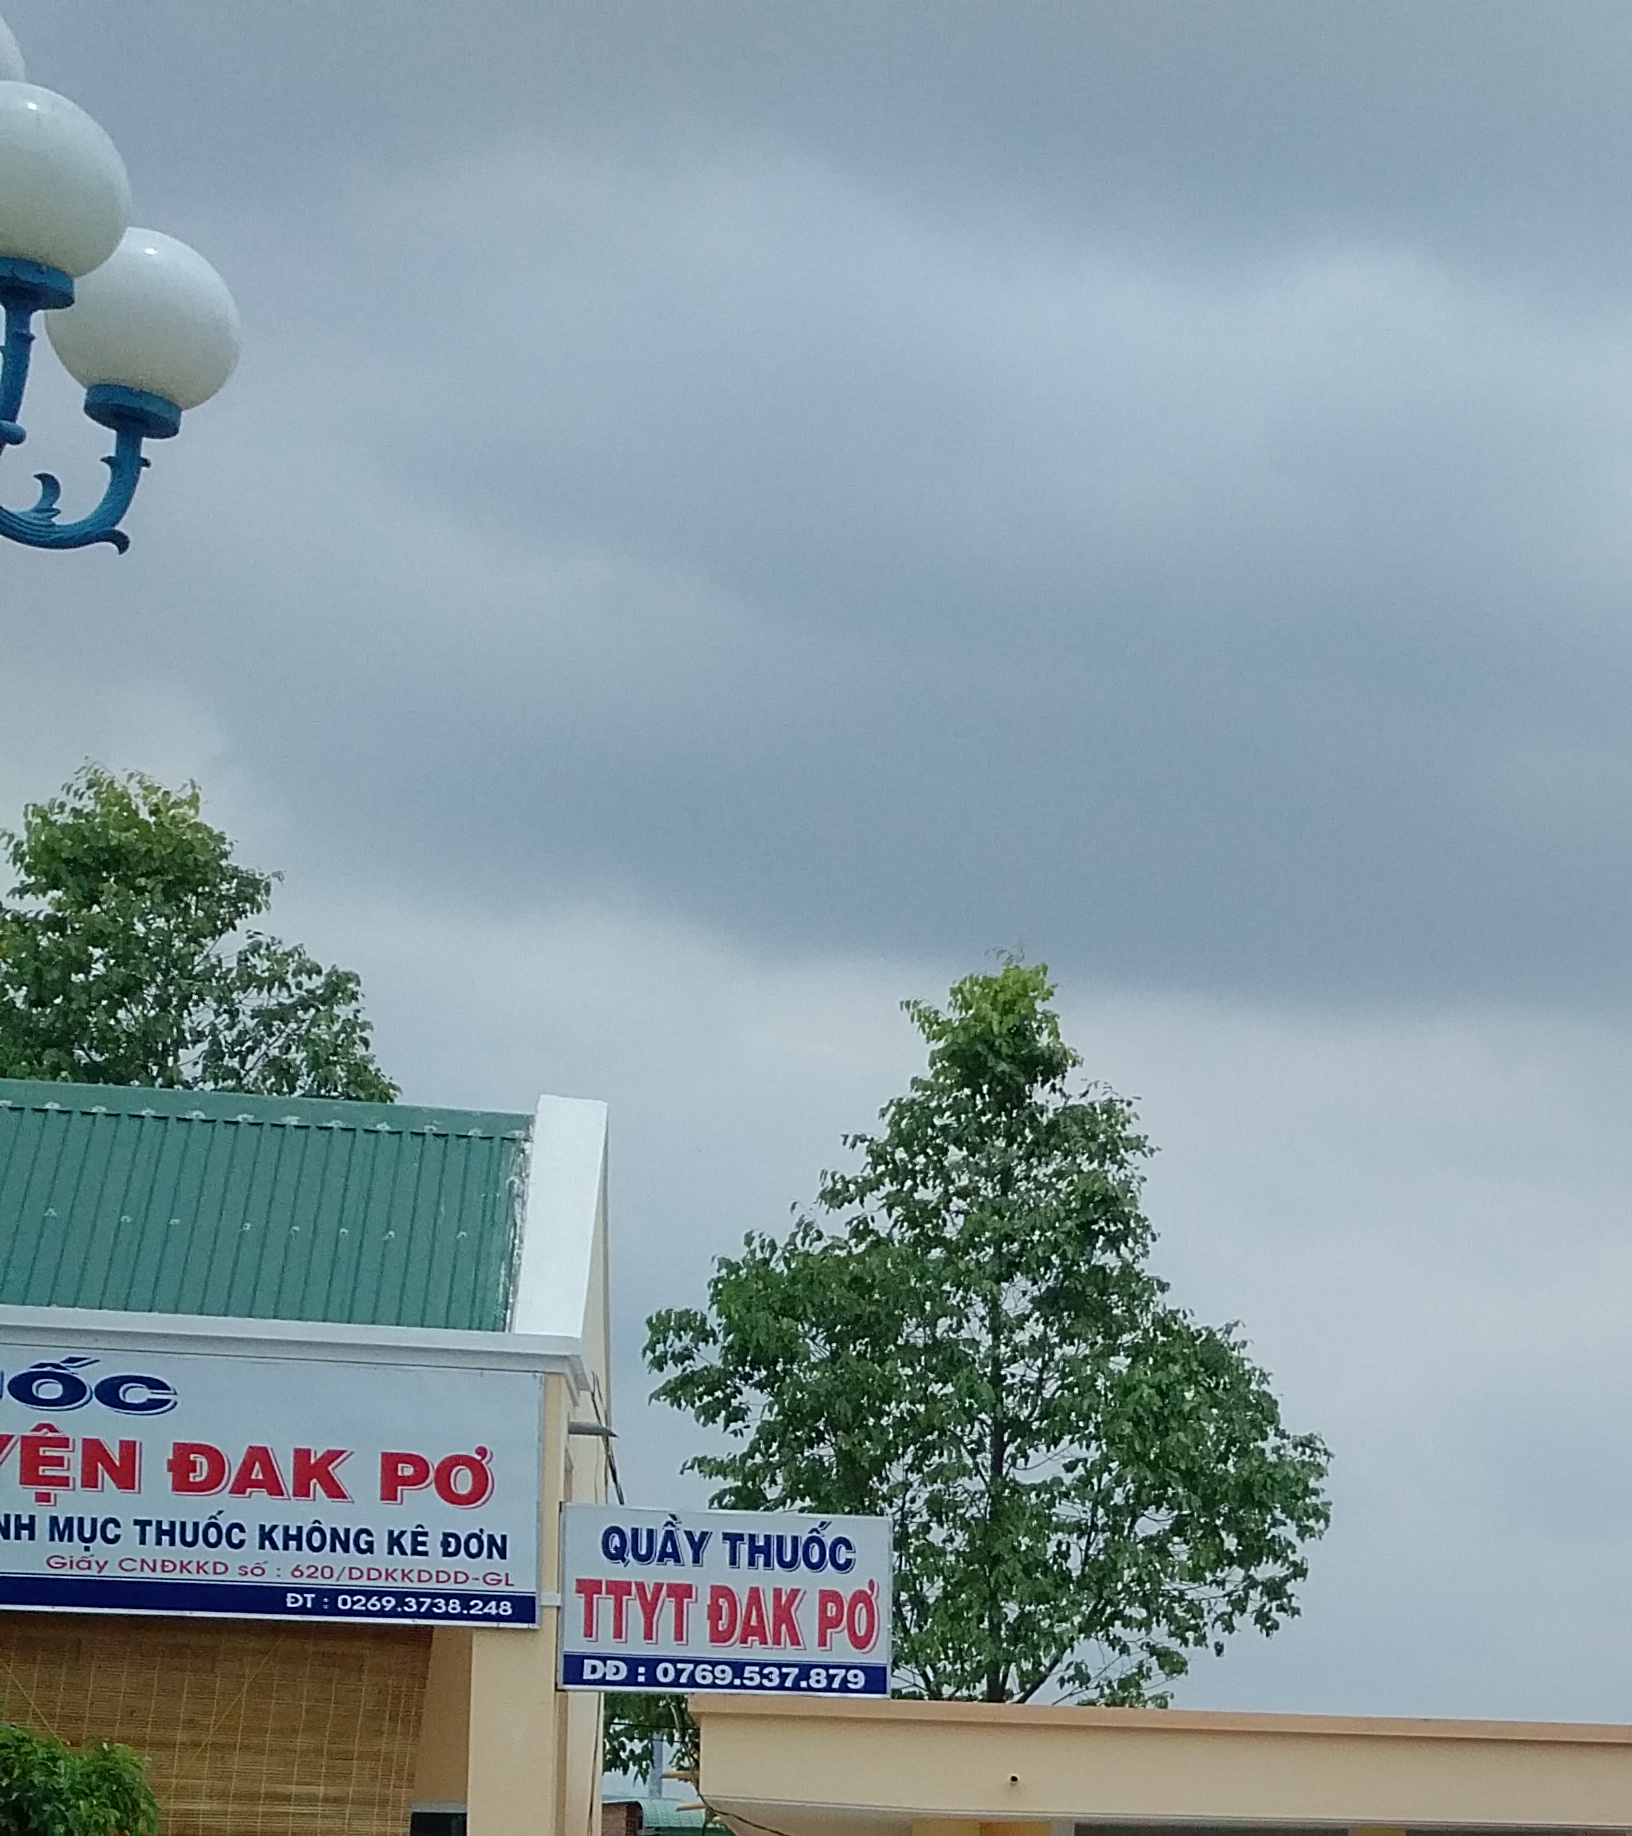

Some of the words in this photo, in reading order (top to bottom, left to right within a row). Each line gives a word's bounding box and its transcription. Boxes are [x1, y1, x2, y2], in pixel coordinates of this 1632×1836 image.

[0, 1356, 177, 1416] ỐC
[0, 1422, 142, 1506] ỆN
[167, 1441, 354, 1504] ĐAK
[380, 1446, 494, 1510] PƠ
[49, 1515, 122, 1552] MỤC
[133, 1510, 246, 1550] THUỐC
[258, 1519, 375, 1556] KHÔNG
[387, 1524, 429, 1558] KÊ
[440, 1528, 508, 1560] ĐƠN
[601, 1513, 713, 1568] QUẦY
[721, 1521, 856, 1574] THUỐC
[46, 1554, 109, 1574] Giấy
[118, 1557, 229, 1576] CNĐKKD
[238, 1560, 270, 1577] số
[290, 1564, 515, 1587] 620/DDKKDDD-GL
[286, 1592, 316, 1609] ĐT
[337, 1594, 513, 1616] 0269.3738.248
[575, 1578, 698, 1646] TTYT
[707, 1584, 807, 1651] ĐAK
[817, 1578, 880, 1653] PƠ
[582, 1659, 628, 1684] DĐ
[656, 1662, 865, 1690] 0769.537.879
